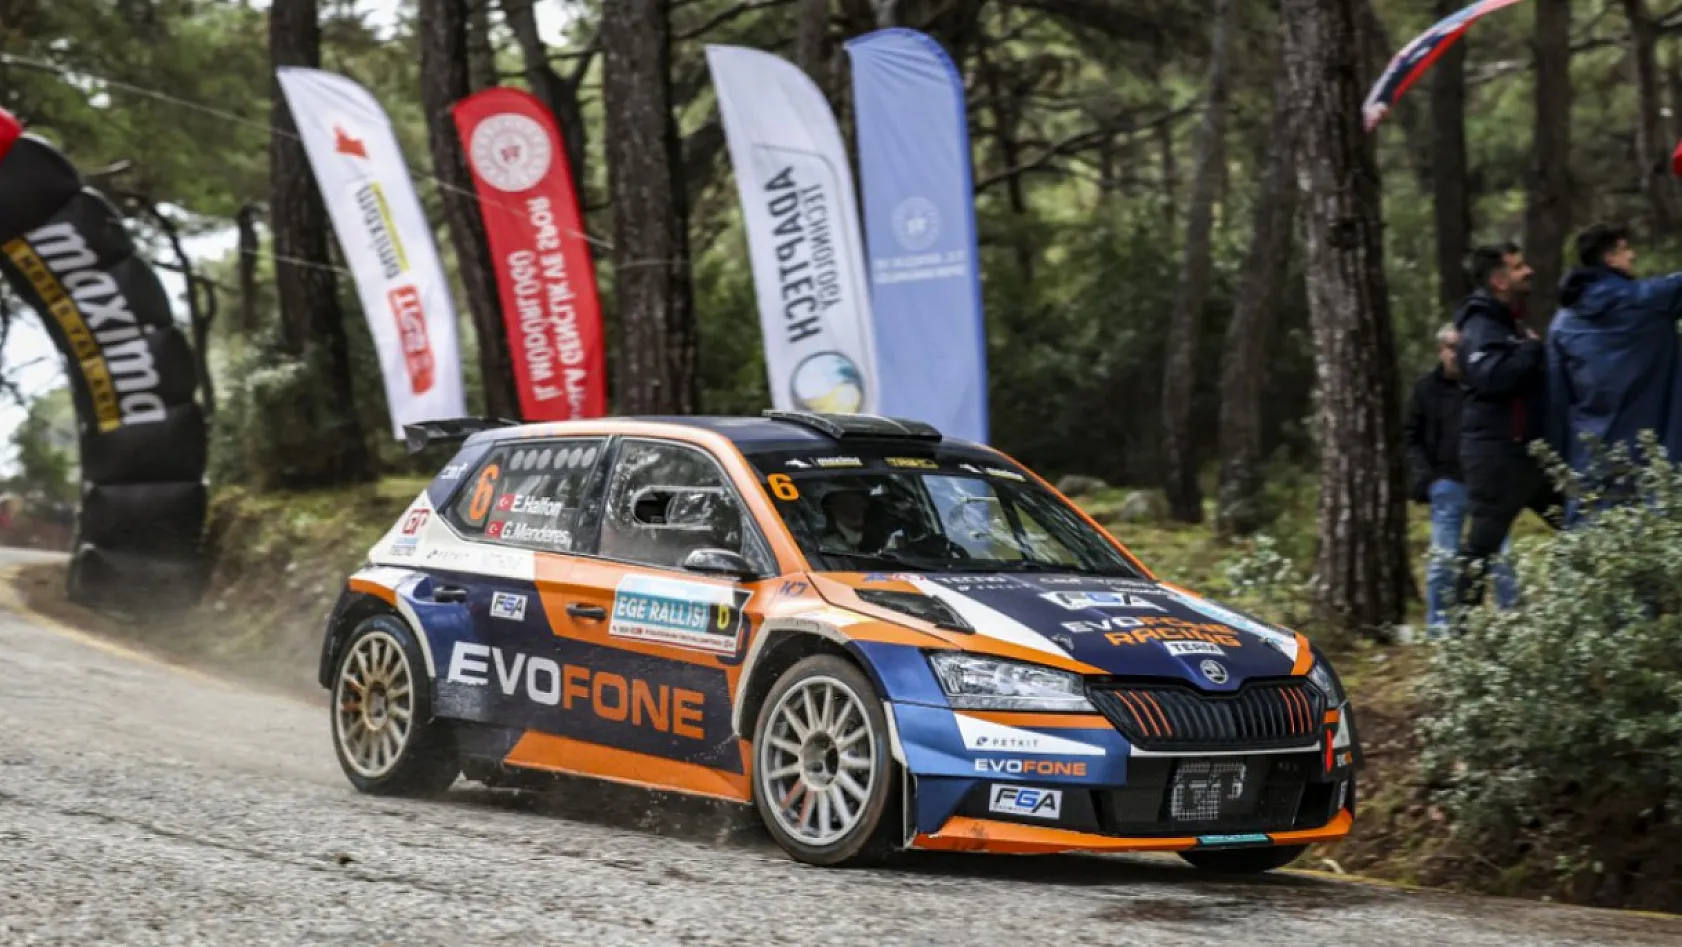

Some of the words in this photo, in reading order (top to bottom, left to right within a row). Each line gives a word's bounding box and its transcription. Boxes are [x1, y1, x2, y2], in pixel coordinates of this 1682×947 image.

[25, 222, 167, 425] maxima
[469, 463, 500, 521] 6
[767, 472, 800, 501] 6
[617, 595, 647, 620] EGE
[1104, 627, 1242, 647] RACING
[447, 641, 705, 740] EVOFONE
[992, 739, 1039, 747] PETKIT
[974, 758, 1088, 777] EVOFONE
[995, 787, 1057, 814] FGA
